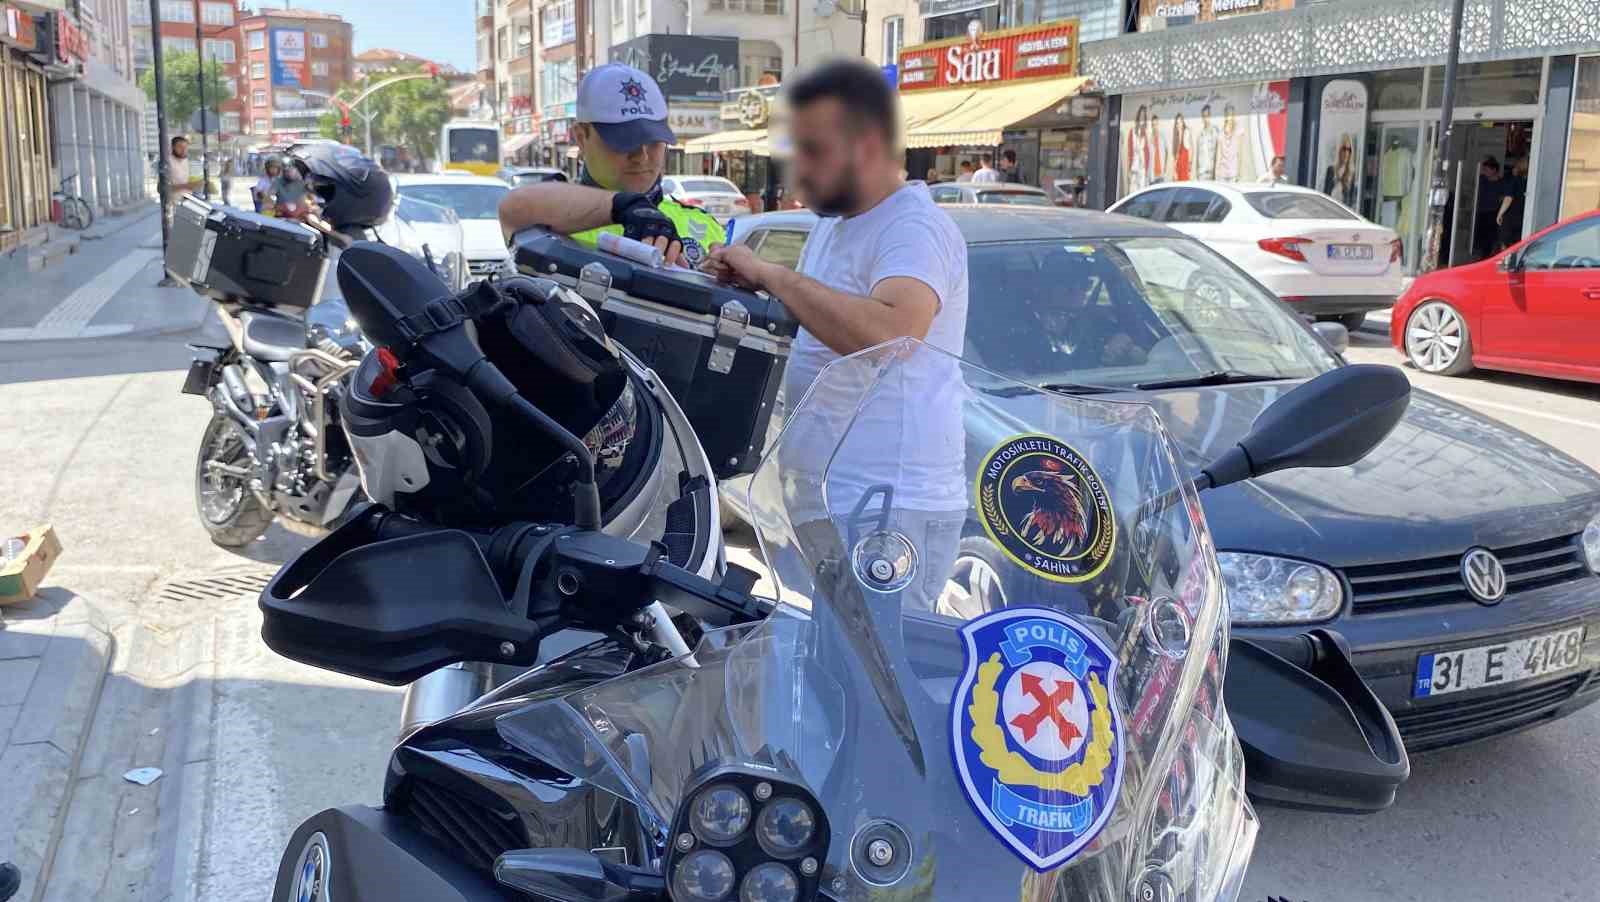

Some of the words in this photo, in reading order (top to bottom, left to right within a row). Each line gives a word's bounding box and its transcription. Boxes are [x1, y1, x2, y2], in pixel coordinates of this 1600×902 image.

[945, 46, 1001, 84] Sara
[987, 440, 1052, 479] MOTOSİKLETLİ
[1054, 444, 1089, 473] TRAFİK
[1033, 557, 1072, 574] ŞAHİN
[1014, 625, 1081, 653] POLİS
[1433, 653, 1465, 690] 31
[1485, 645, 1508, 683] E
[1522, 630, 1580, 675] 4148
[1017, 803, 1073, 828] TRAFİK
